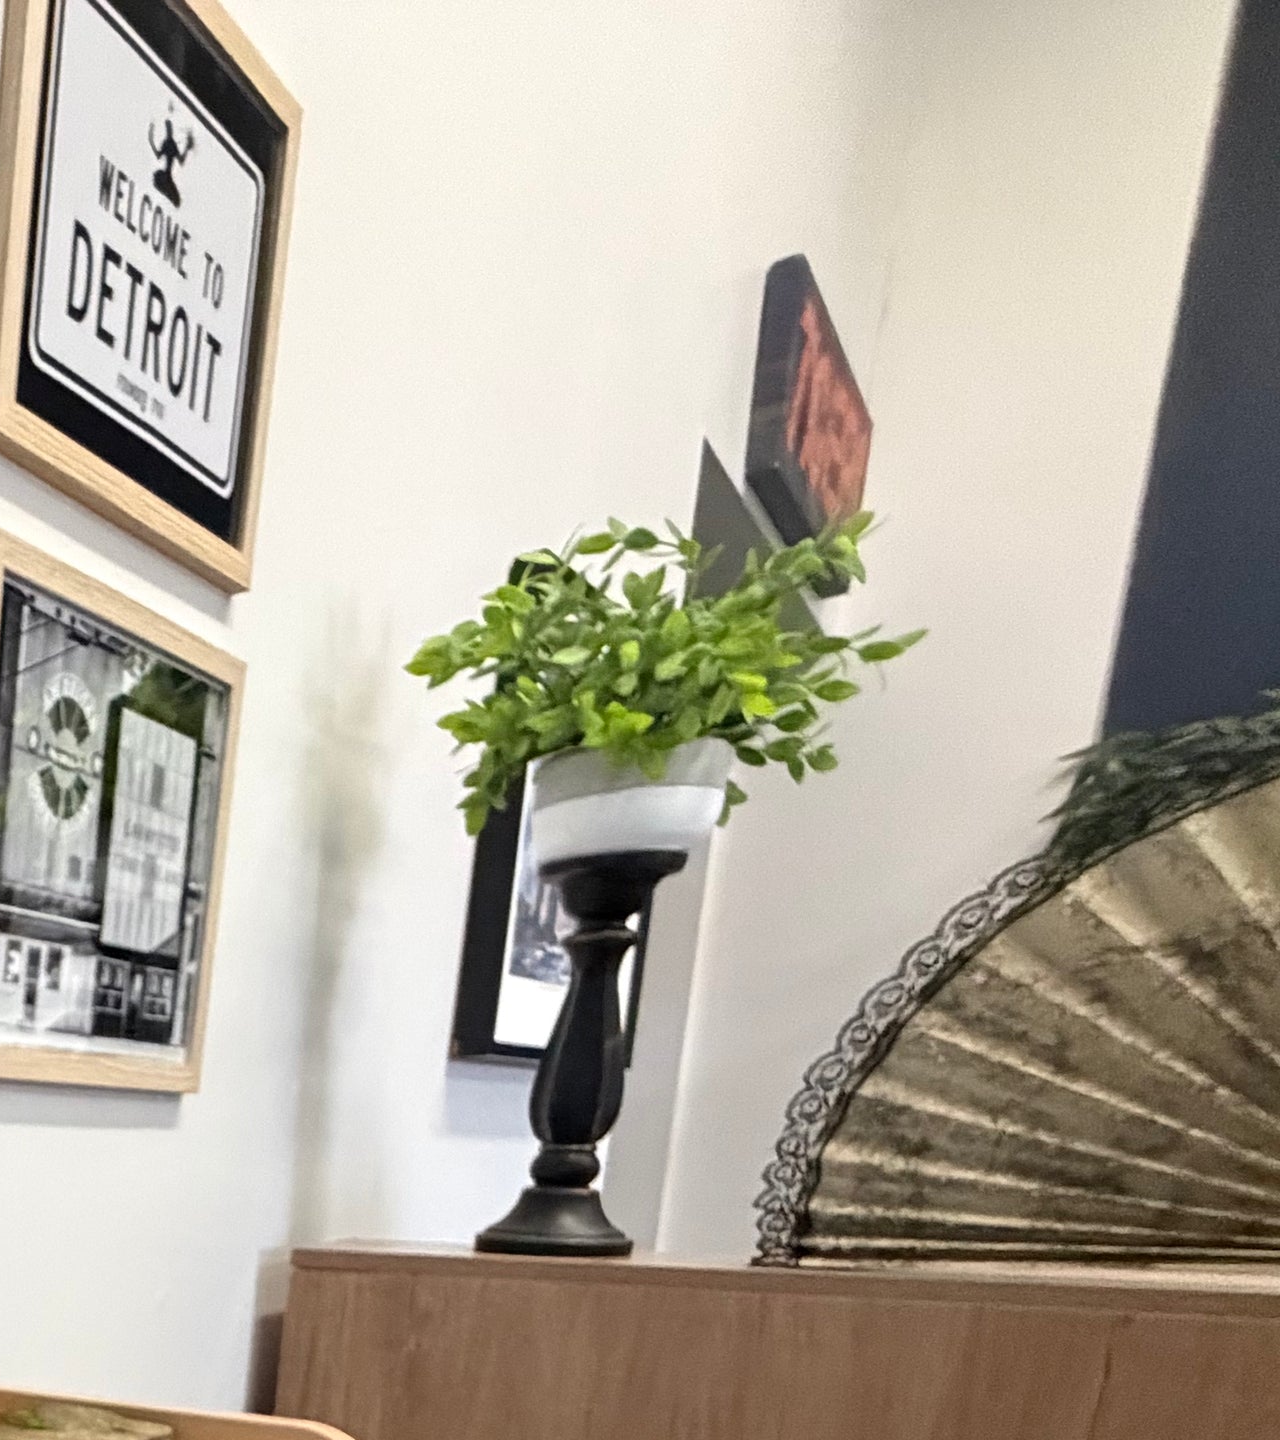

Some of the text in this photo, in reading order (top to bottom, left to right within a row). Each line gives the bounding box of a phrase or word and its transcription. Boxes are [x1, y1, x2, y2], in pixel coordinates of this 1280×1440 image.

[66, 218, 222, 423] DETROIT
[98, 154, 224, 310] WELCOME TO
